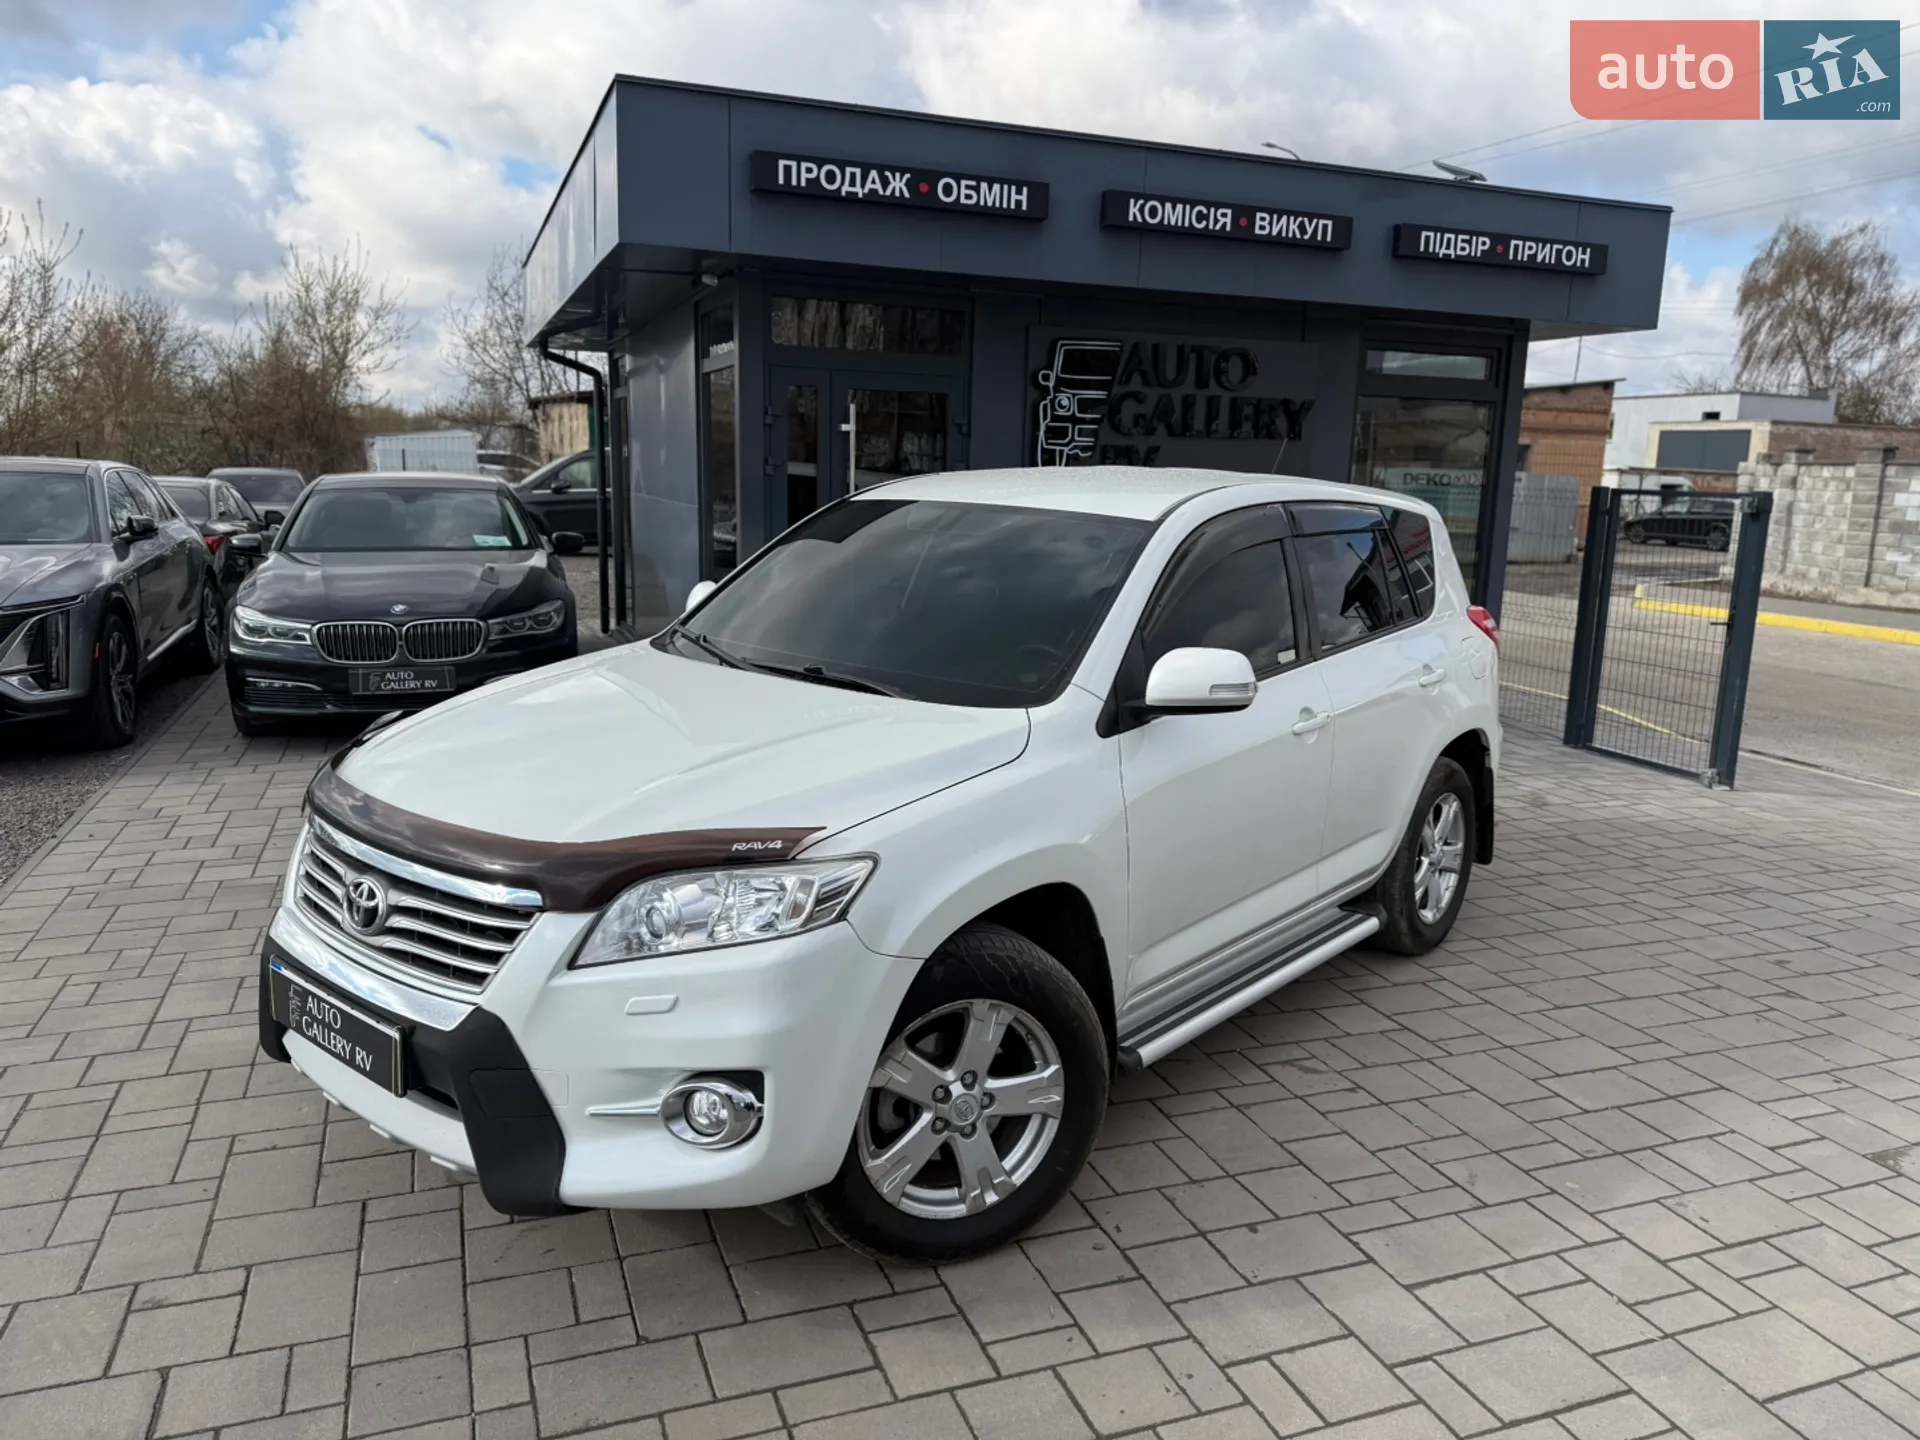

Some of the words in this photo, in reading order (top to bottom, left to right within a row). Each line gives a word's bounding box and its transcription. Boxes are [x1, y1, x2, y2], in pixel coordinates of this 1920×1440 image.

[778, 159, 911, 198] ПРОДАЖ
[937, 177, 1028, 210] ОБМІН
[1127, 198, 1232, 231] КОМІСІЯ
[1254, 211, 1333, 242] ВИКУП
[1419, 230, 1491, 259] ПІДБІР
[1508, 239, 1591, 268] ПРИГОН
[1117, 340, 1261, 392] AUTO
[1106, 389, 1316, 441] GALLERY
[381, 680, 422, 690] GALLERY
[424, 680, 438, 688] RV
[385, 671, 414, 680] AUTO
[731, 840, 783, 851] RAV4
[306, 994, 341, 1029] AUTO
[302, 1015, 352, 1060] GALLERY
[355, 1046, 373, 1072] RV
